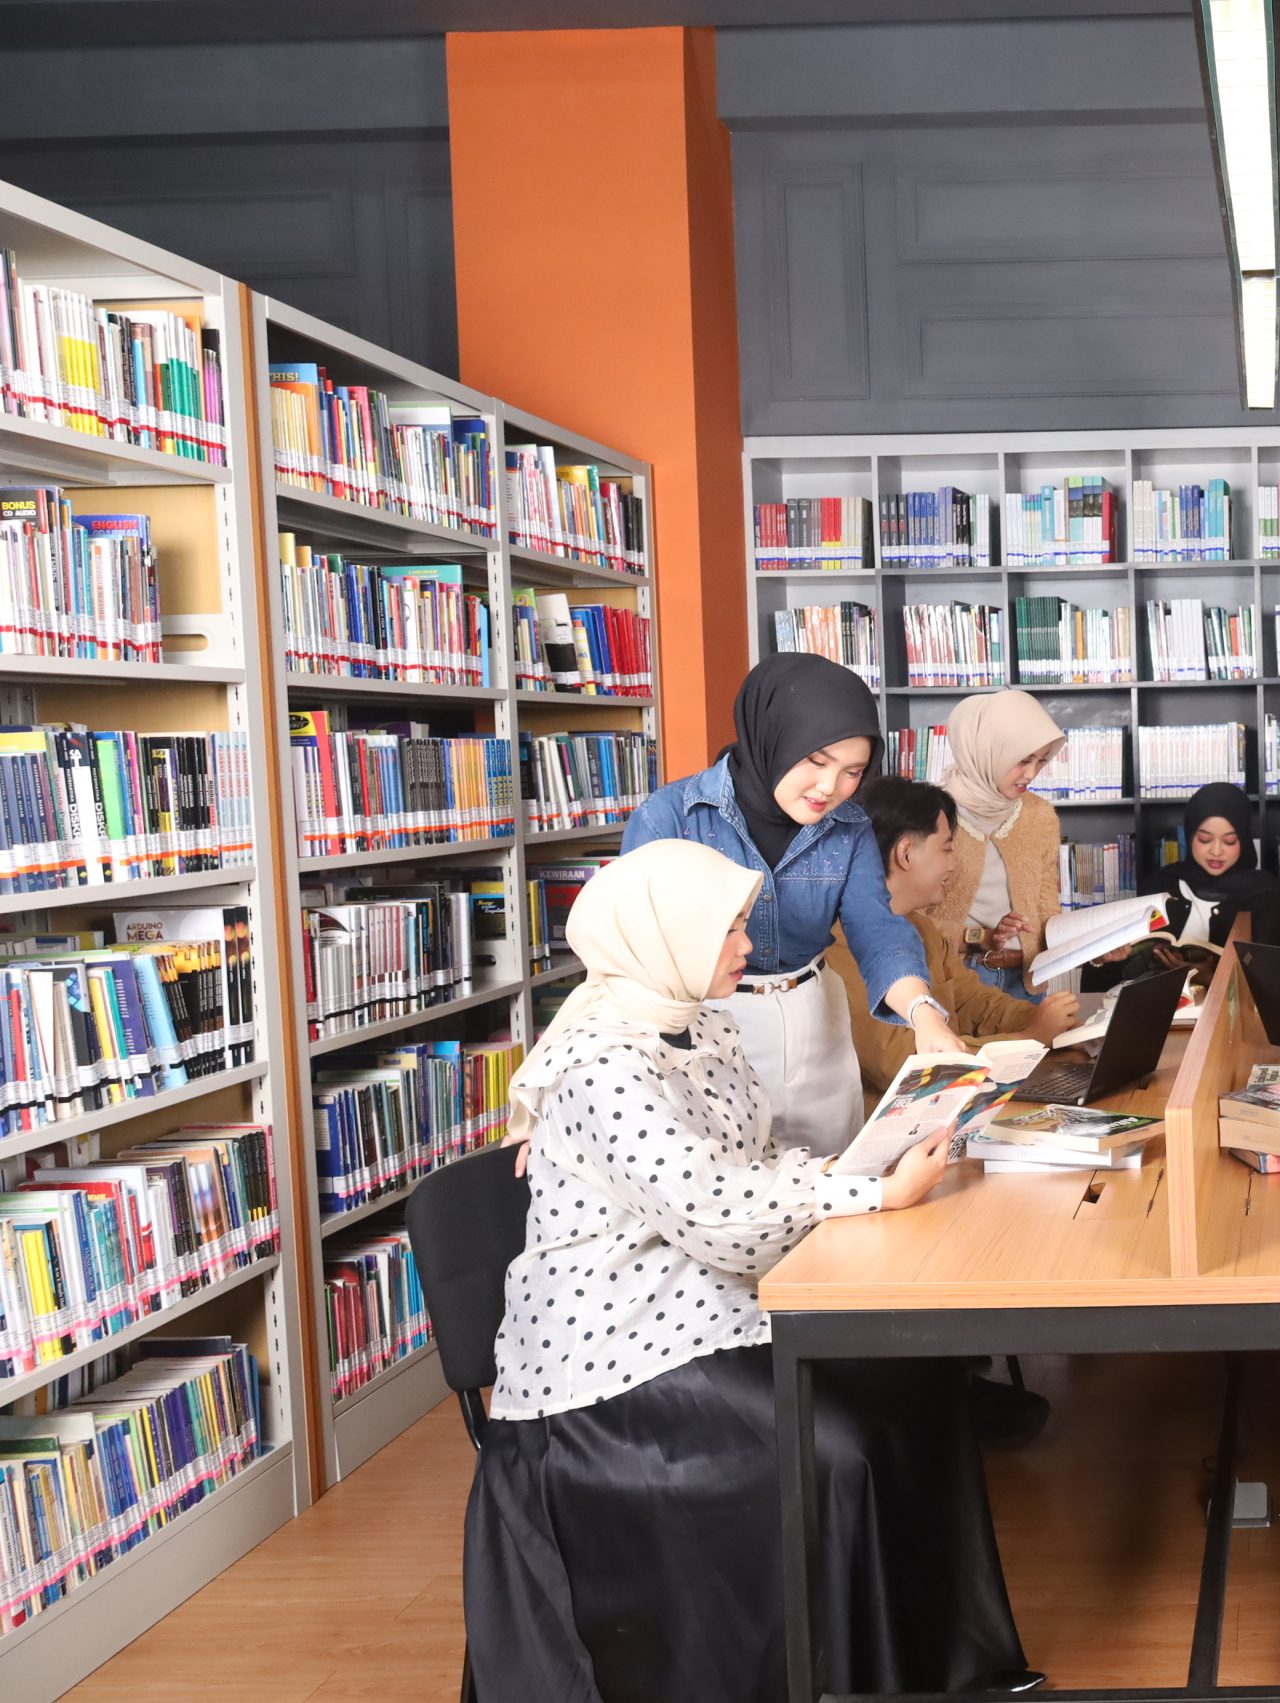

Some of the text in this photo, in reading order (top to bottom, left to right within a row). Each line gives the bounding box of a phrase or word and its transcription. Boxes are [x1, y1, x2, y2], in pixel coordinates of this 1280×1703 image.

[270, 372, 299, 381] HIS!
[2, 501, 36, 510] BONUS
[92, 521, 138, 529] ENGLISH
[127, 922, 163, 931] ARDUINO
[126, 930, 164, 941] MEGA
